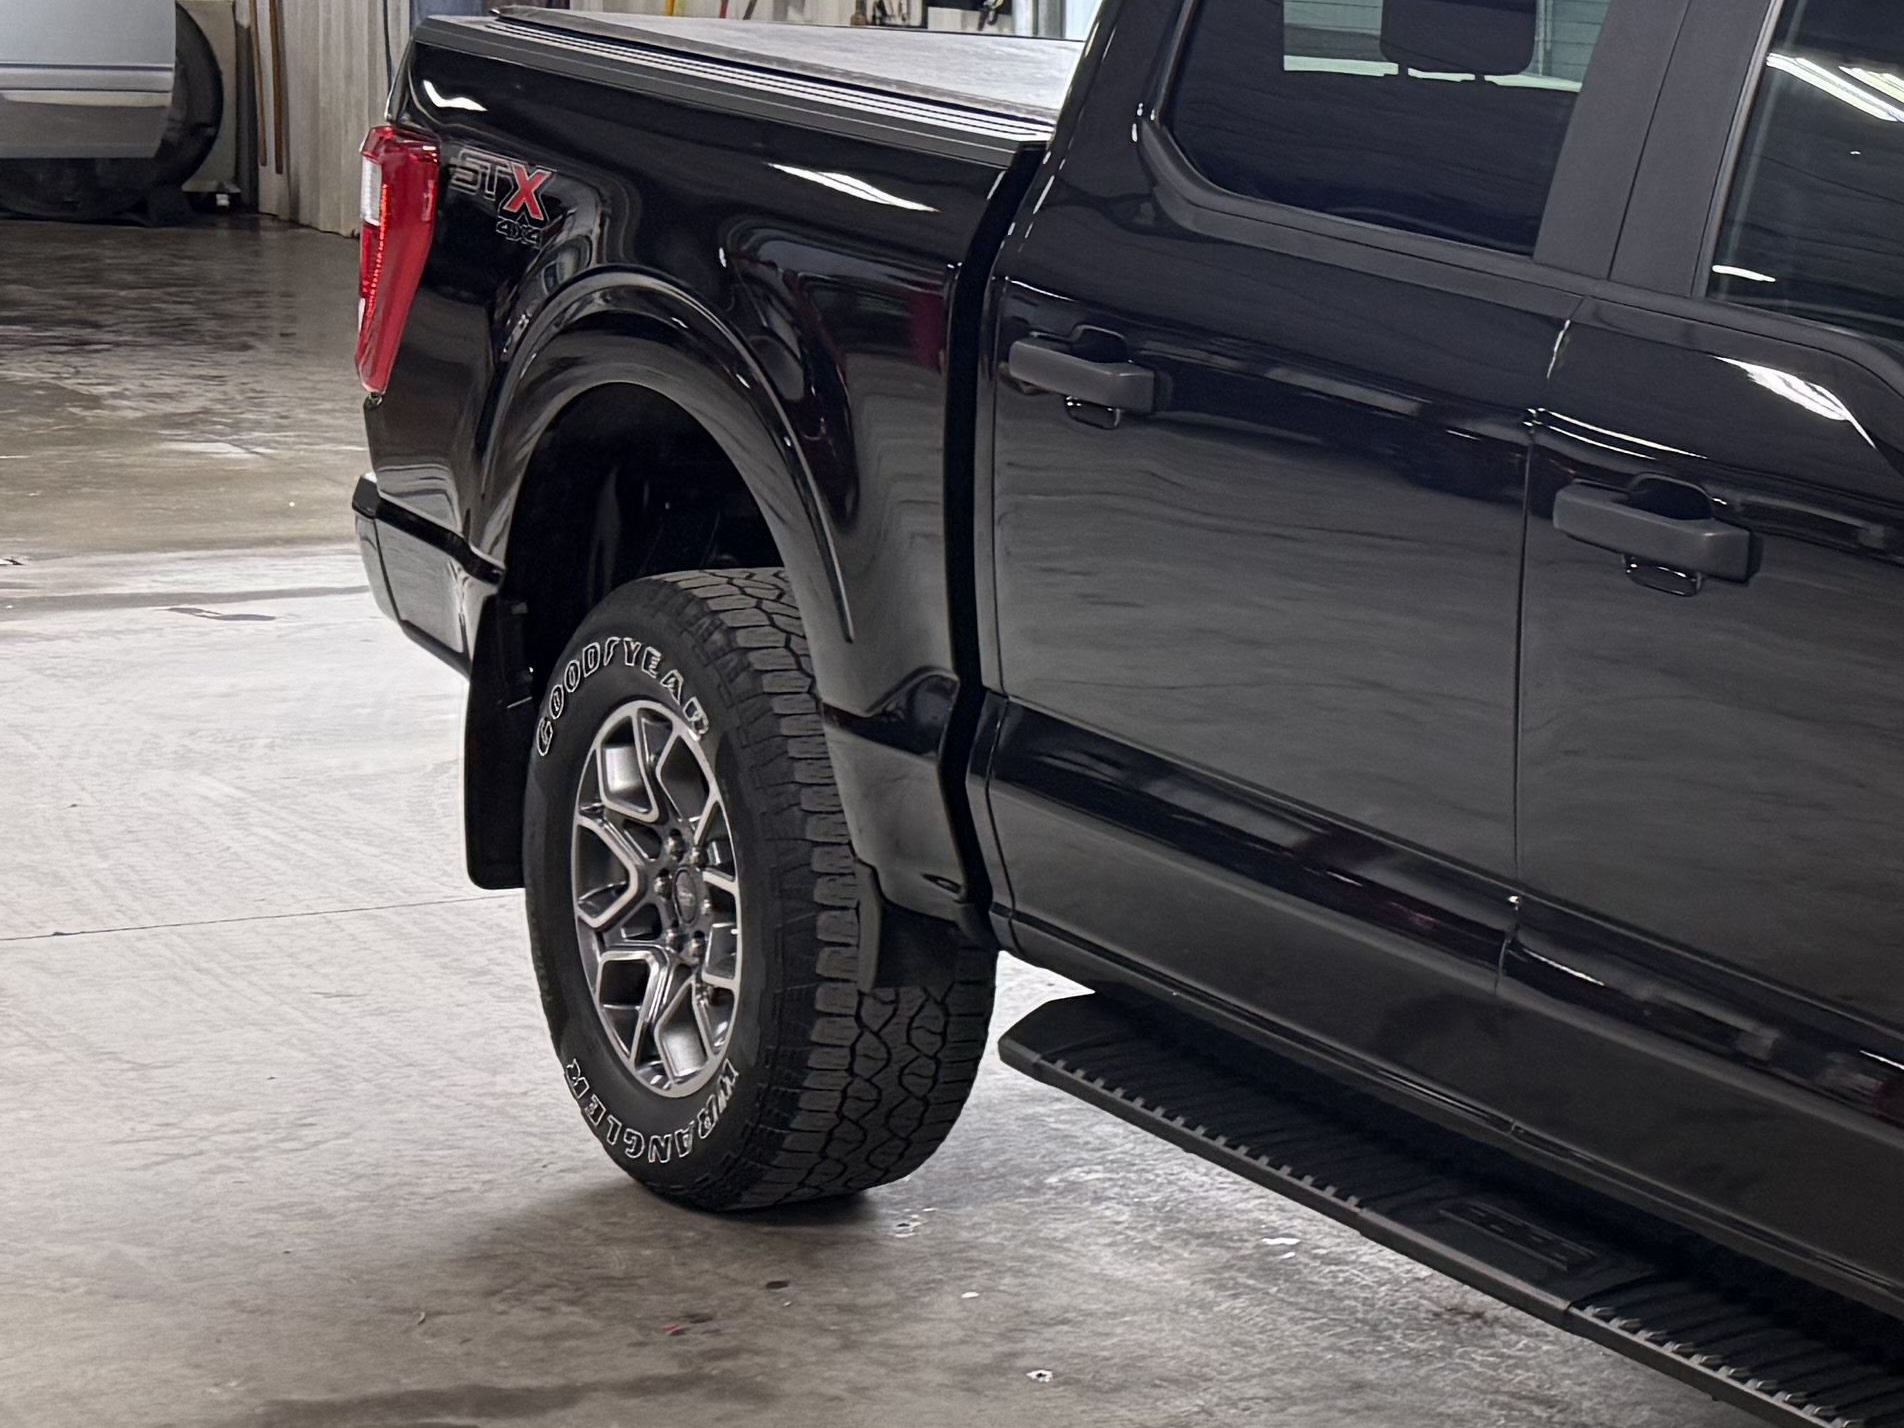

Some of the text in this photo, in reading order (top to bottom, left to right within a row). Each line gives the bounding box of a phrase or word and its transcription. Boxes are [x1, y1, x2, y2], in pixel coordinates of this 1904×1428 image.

[448, 146, 553, 222] STX
[534, 635, 711, 758] GOODYEAR
[562, 1056, 740, 1164] WRANGLER
